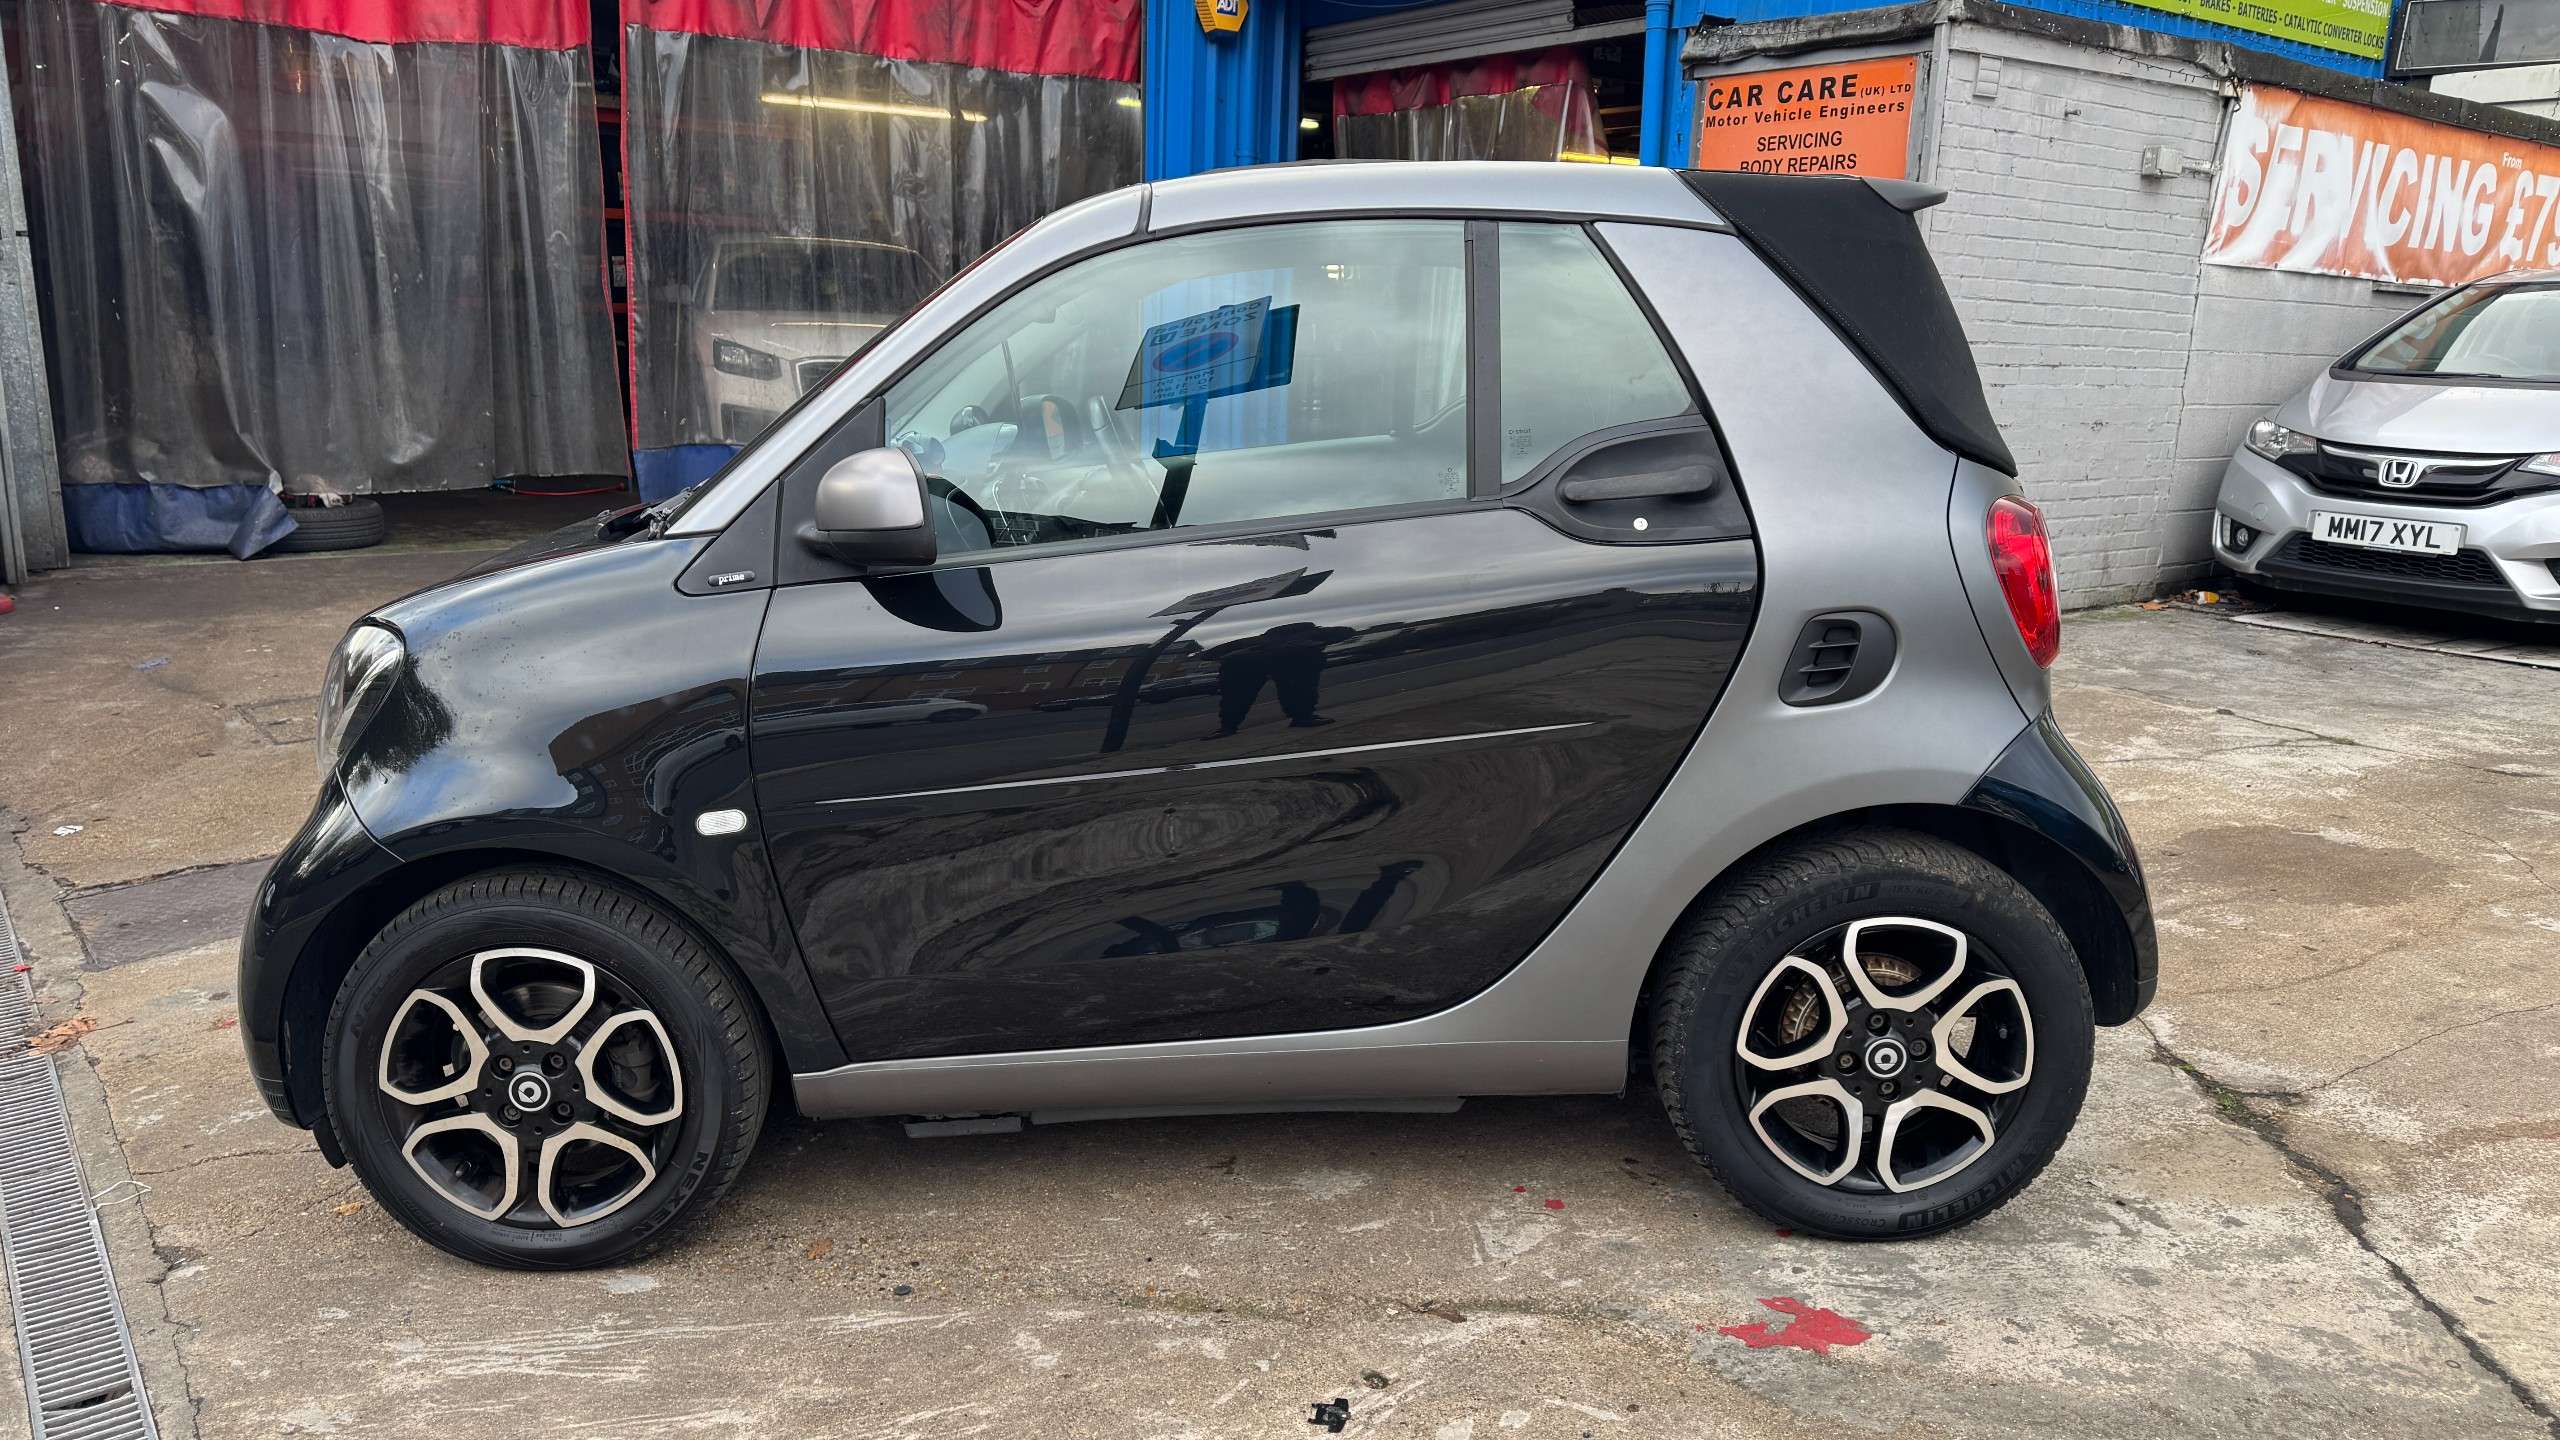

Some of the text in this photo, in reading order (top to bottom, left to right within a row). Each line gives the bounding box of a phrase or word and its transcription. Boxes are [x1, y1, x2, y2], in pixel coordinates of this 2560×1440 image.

[2237, 2, 2278, 24] BATTERIES
[2283, 13, 2322, 35] CATALYTIC
[2323, 23, 2362, 45] CONVERTER
[2363, 30, 2385, 49] LOCKS
[1708, 73, 1911, 110] CAR CARE (UK) LTD
[1705, 101, 1905, 128] Motor Vehicle Engineers
[1756, 130, 1843, 152] SERVICING
[1740, 153, 1857, 174] BODY REPAIRS
[2502, 151, 2523, 169] From
[2220, 116, 2498, 257] SERVICING
[2327, 516, 2441, 549] MM17 XYL
[718, 572, 745, 585] prime
[631, 1150, 710, 1238] NEXEN
